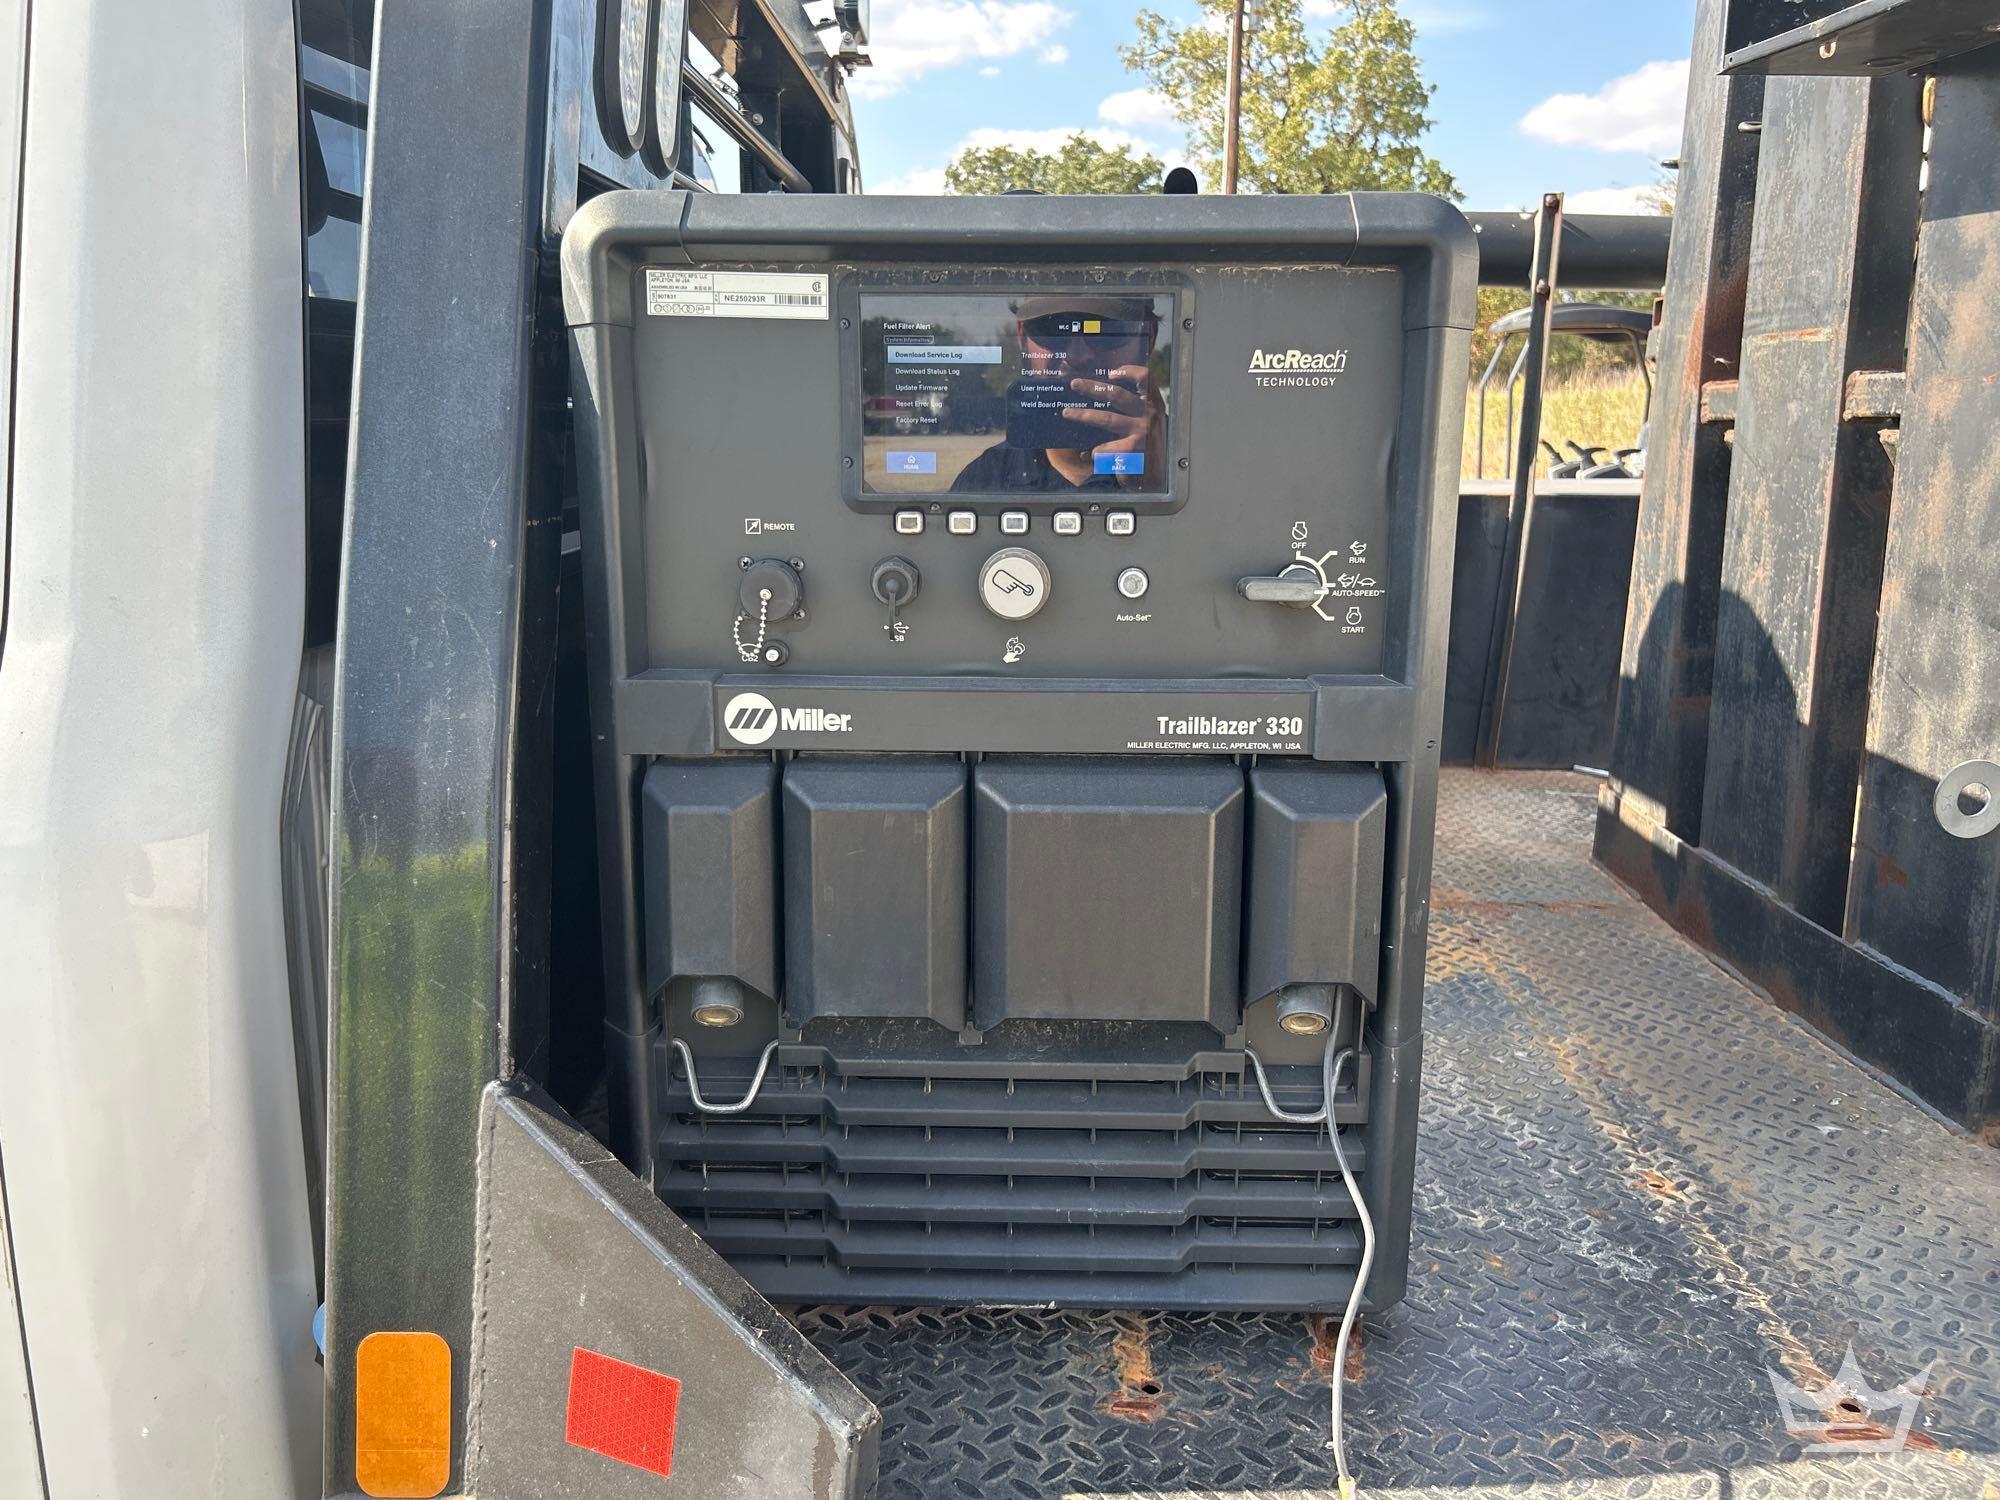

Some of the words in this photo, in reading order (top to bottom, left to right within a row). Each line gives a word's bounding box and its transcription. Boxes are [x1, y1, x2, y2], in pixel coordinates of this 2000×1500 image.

[724, 294, 766, 303] NE250293R
[883, 322, 898, 330] Fuel
[898, 322, 914, 330] Filter
[916, 322, 931, 330] Alert
[895, 351, 926, 359] Download
[927, 351, 950, 359] Service
[950, 352, 963, 360] Log
[1249, 349, 1347, 369] ArcReach
[895, 367, 926, 375] Download
[926, 367, 947, 375] Status
[948, 368, 960, 376] Log
[1021, 368, 1042, 376] Engine
[1043, 368, 1062, 376] Hours
[1255, 377, 1337, 387] TECHNOLOGY
[895, 384, 918, 392] Update
[1036, 384, 1064, 392] Interface
[895, 416, 919, 425] Factory
[919, 416, 938, 424] Reset
[764, 522, 796, 531] REMOTE
[1348, 556, 1366, 564] RUN
[1265, 716, 1303, 736] 330
[1127, 741, 1154, 749] MILLER
[1155, 741, 1191, 750] ELECTRIC
[1192, 742, 1211, 750] MFG.
[1212, 742, 1229, 751] LLC,
[1229, 742, 1271, 751] APPLETON,
[1272, 742, 1282, 750] WI
[1285, 742, 1301, 750] USA
